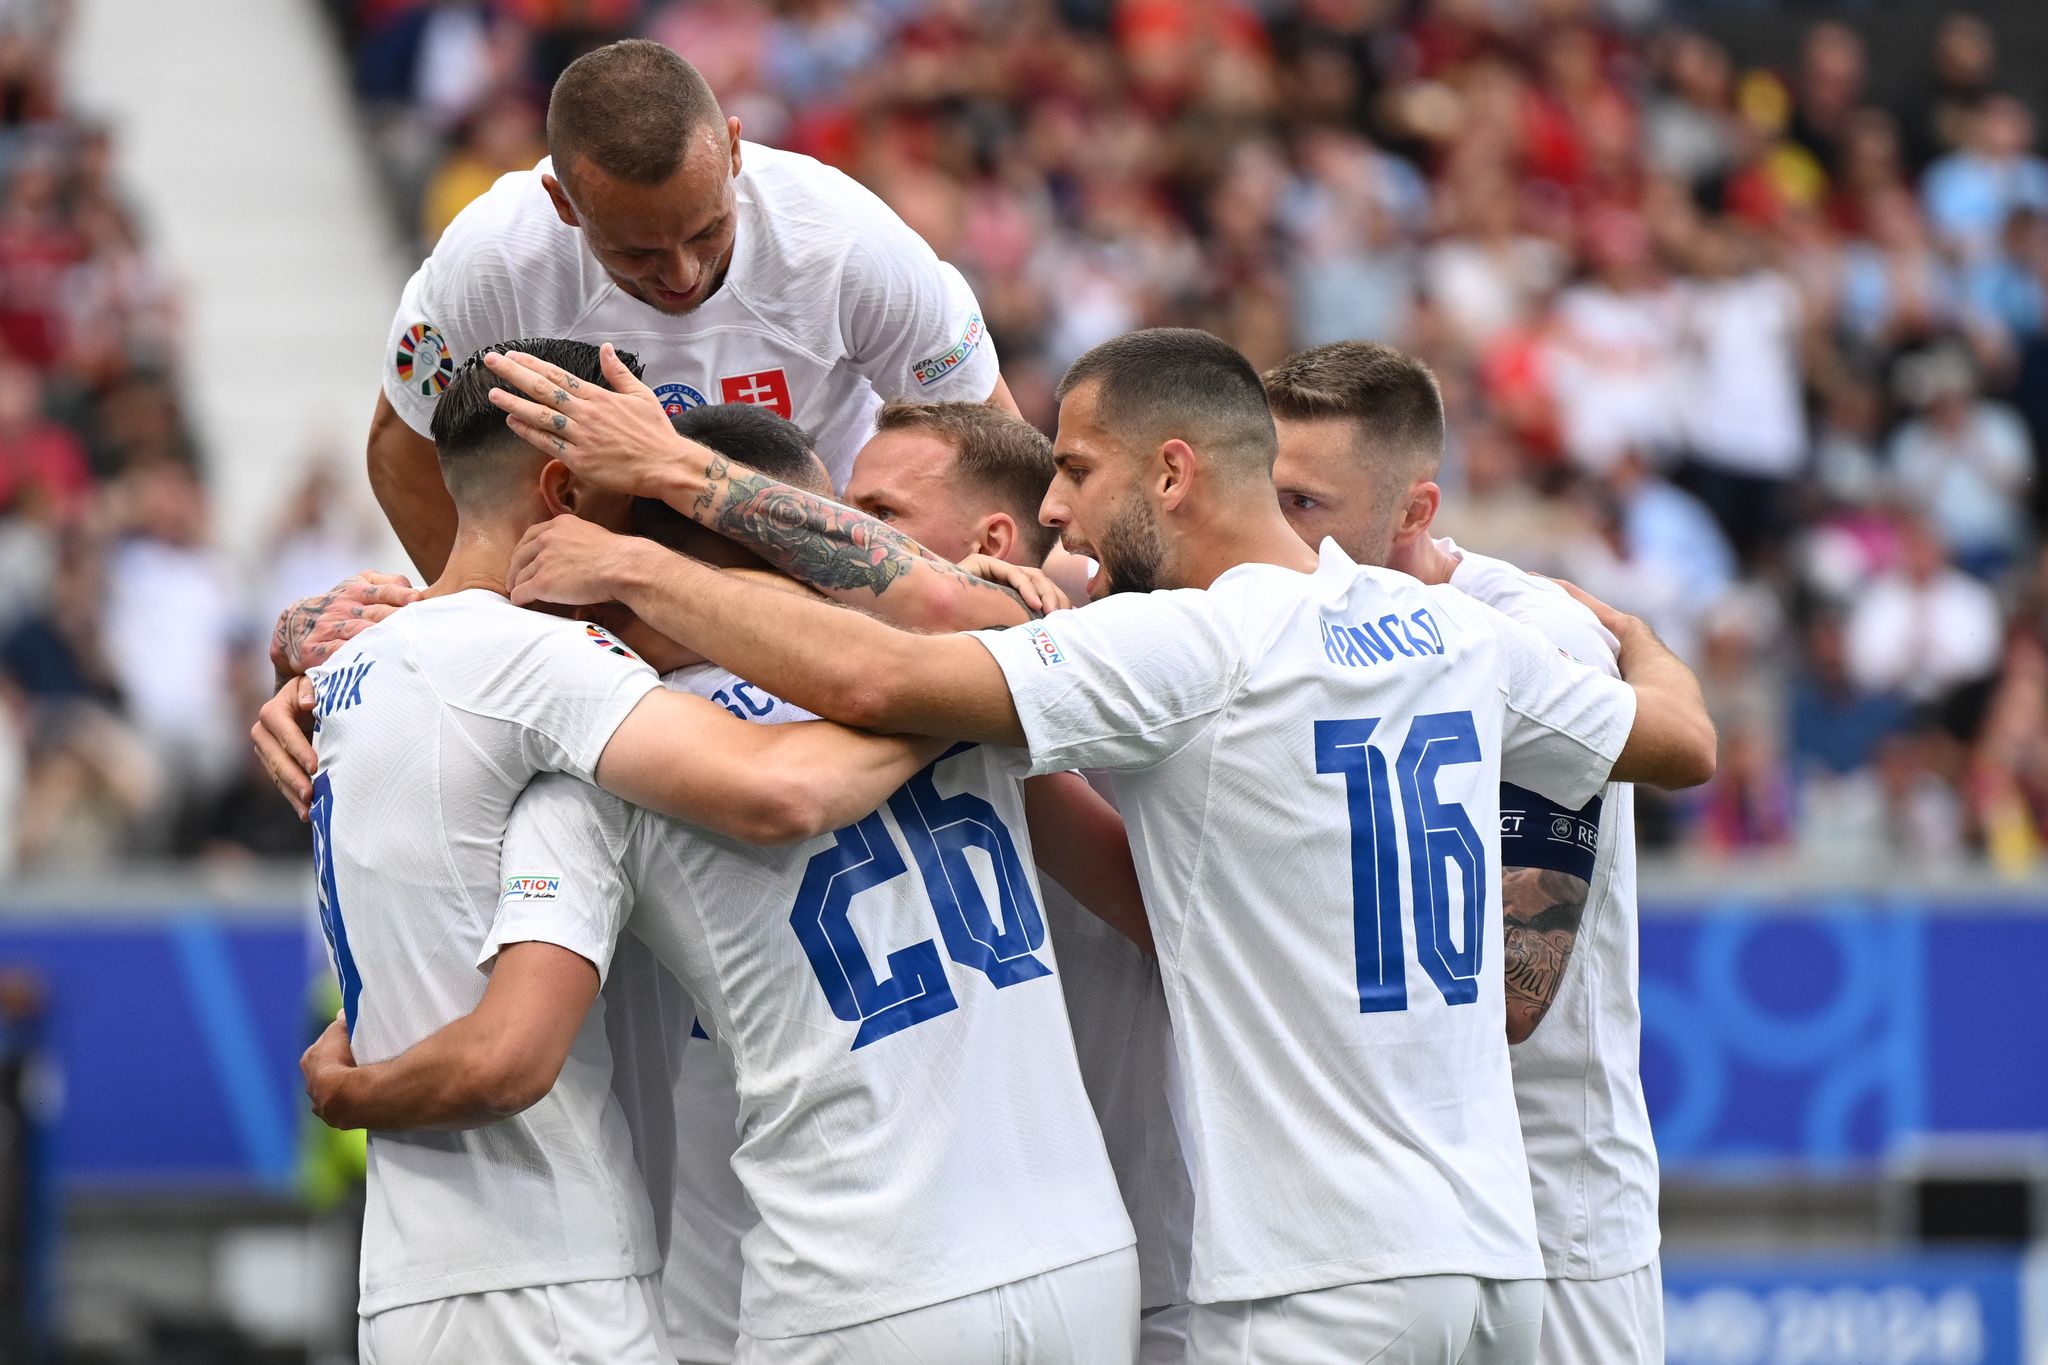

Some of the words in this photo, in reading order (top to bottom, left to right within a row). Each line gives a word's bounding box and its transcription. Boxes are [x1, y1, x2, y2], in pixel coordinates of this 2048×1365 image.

[912, 359, 933, 372] UEFA
[916, 313, 980, 383] FOUNDATION
[788, 741, 1055, 1052] 26
[1314, 710, 1486, 1014] 16
